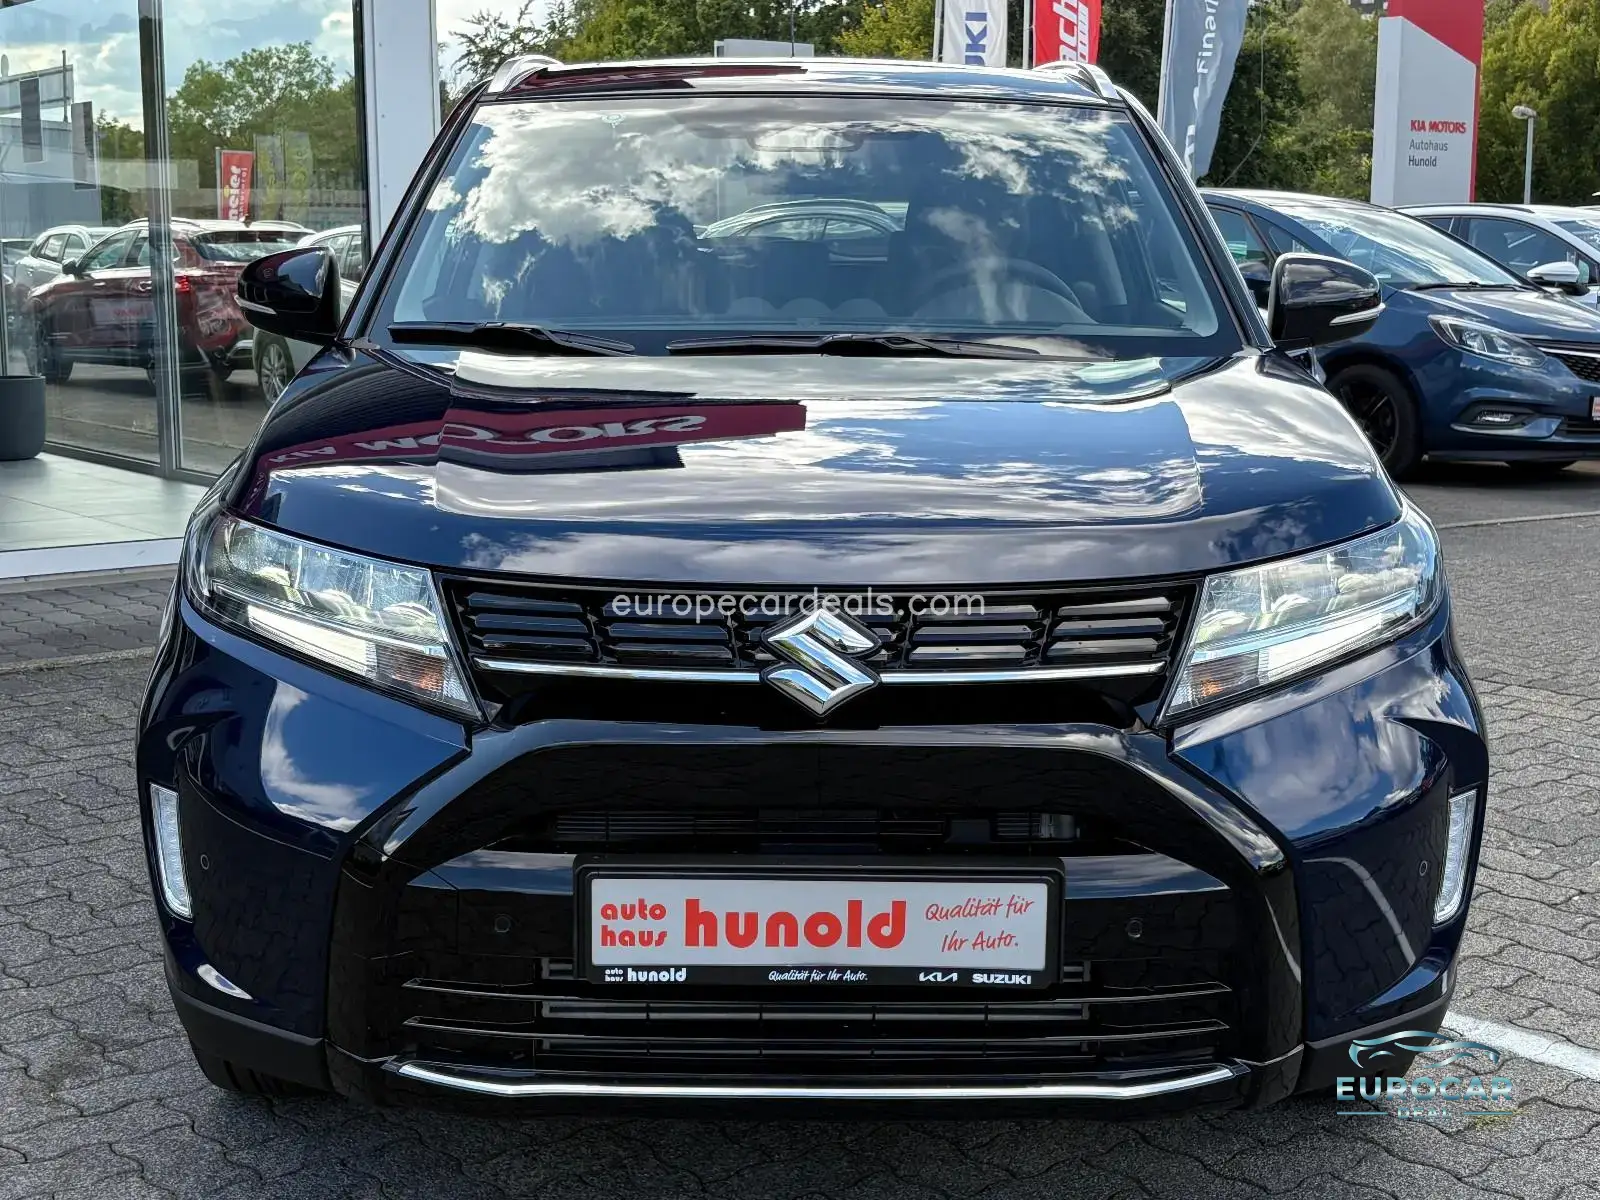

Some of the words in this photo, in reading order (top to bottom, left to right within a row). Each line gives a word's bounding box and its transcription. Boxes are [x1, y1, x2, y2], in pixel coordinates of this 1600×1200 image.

[1410, 120, 1426, 132] KIA
[1428, 121, 1466, 134] MOTORS
[1409, 139, 1449, 151] Autohaus
[1408, 155, 1437, 167] Hunold
[600, 898, 666, 920] auto
[925, 898, 1003, 922] Qualität
[1006, 894, 1035, 918] für
[685, 898, 906, 949] hunold
[600, 925, 667, 947] haus
[941, 930, 969, 952] Ihr
[971, 930, 1019, 951] Auto.
[627, 968, 687, 982] hunold
[768, 969, 809, 982] Qualität
[810, 970, 825, 982] für
[826, 969, 841, 982] Ihr
[843, 970, 869, 981] Auto.
[972, 973, 1032, 985] SUZUKI
